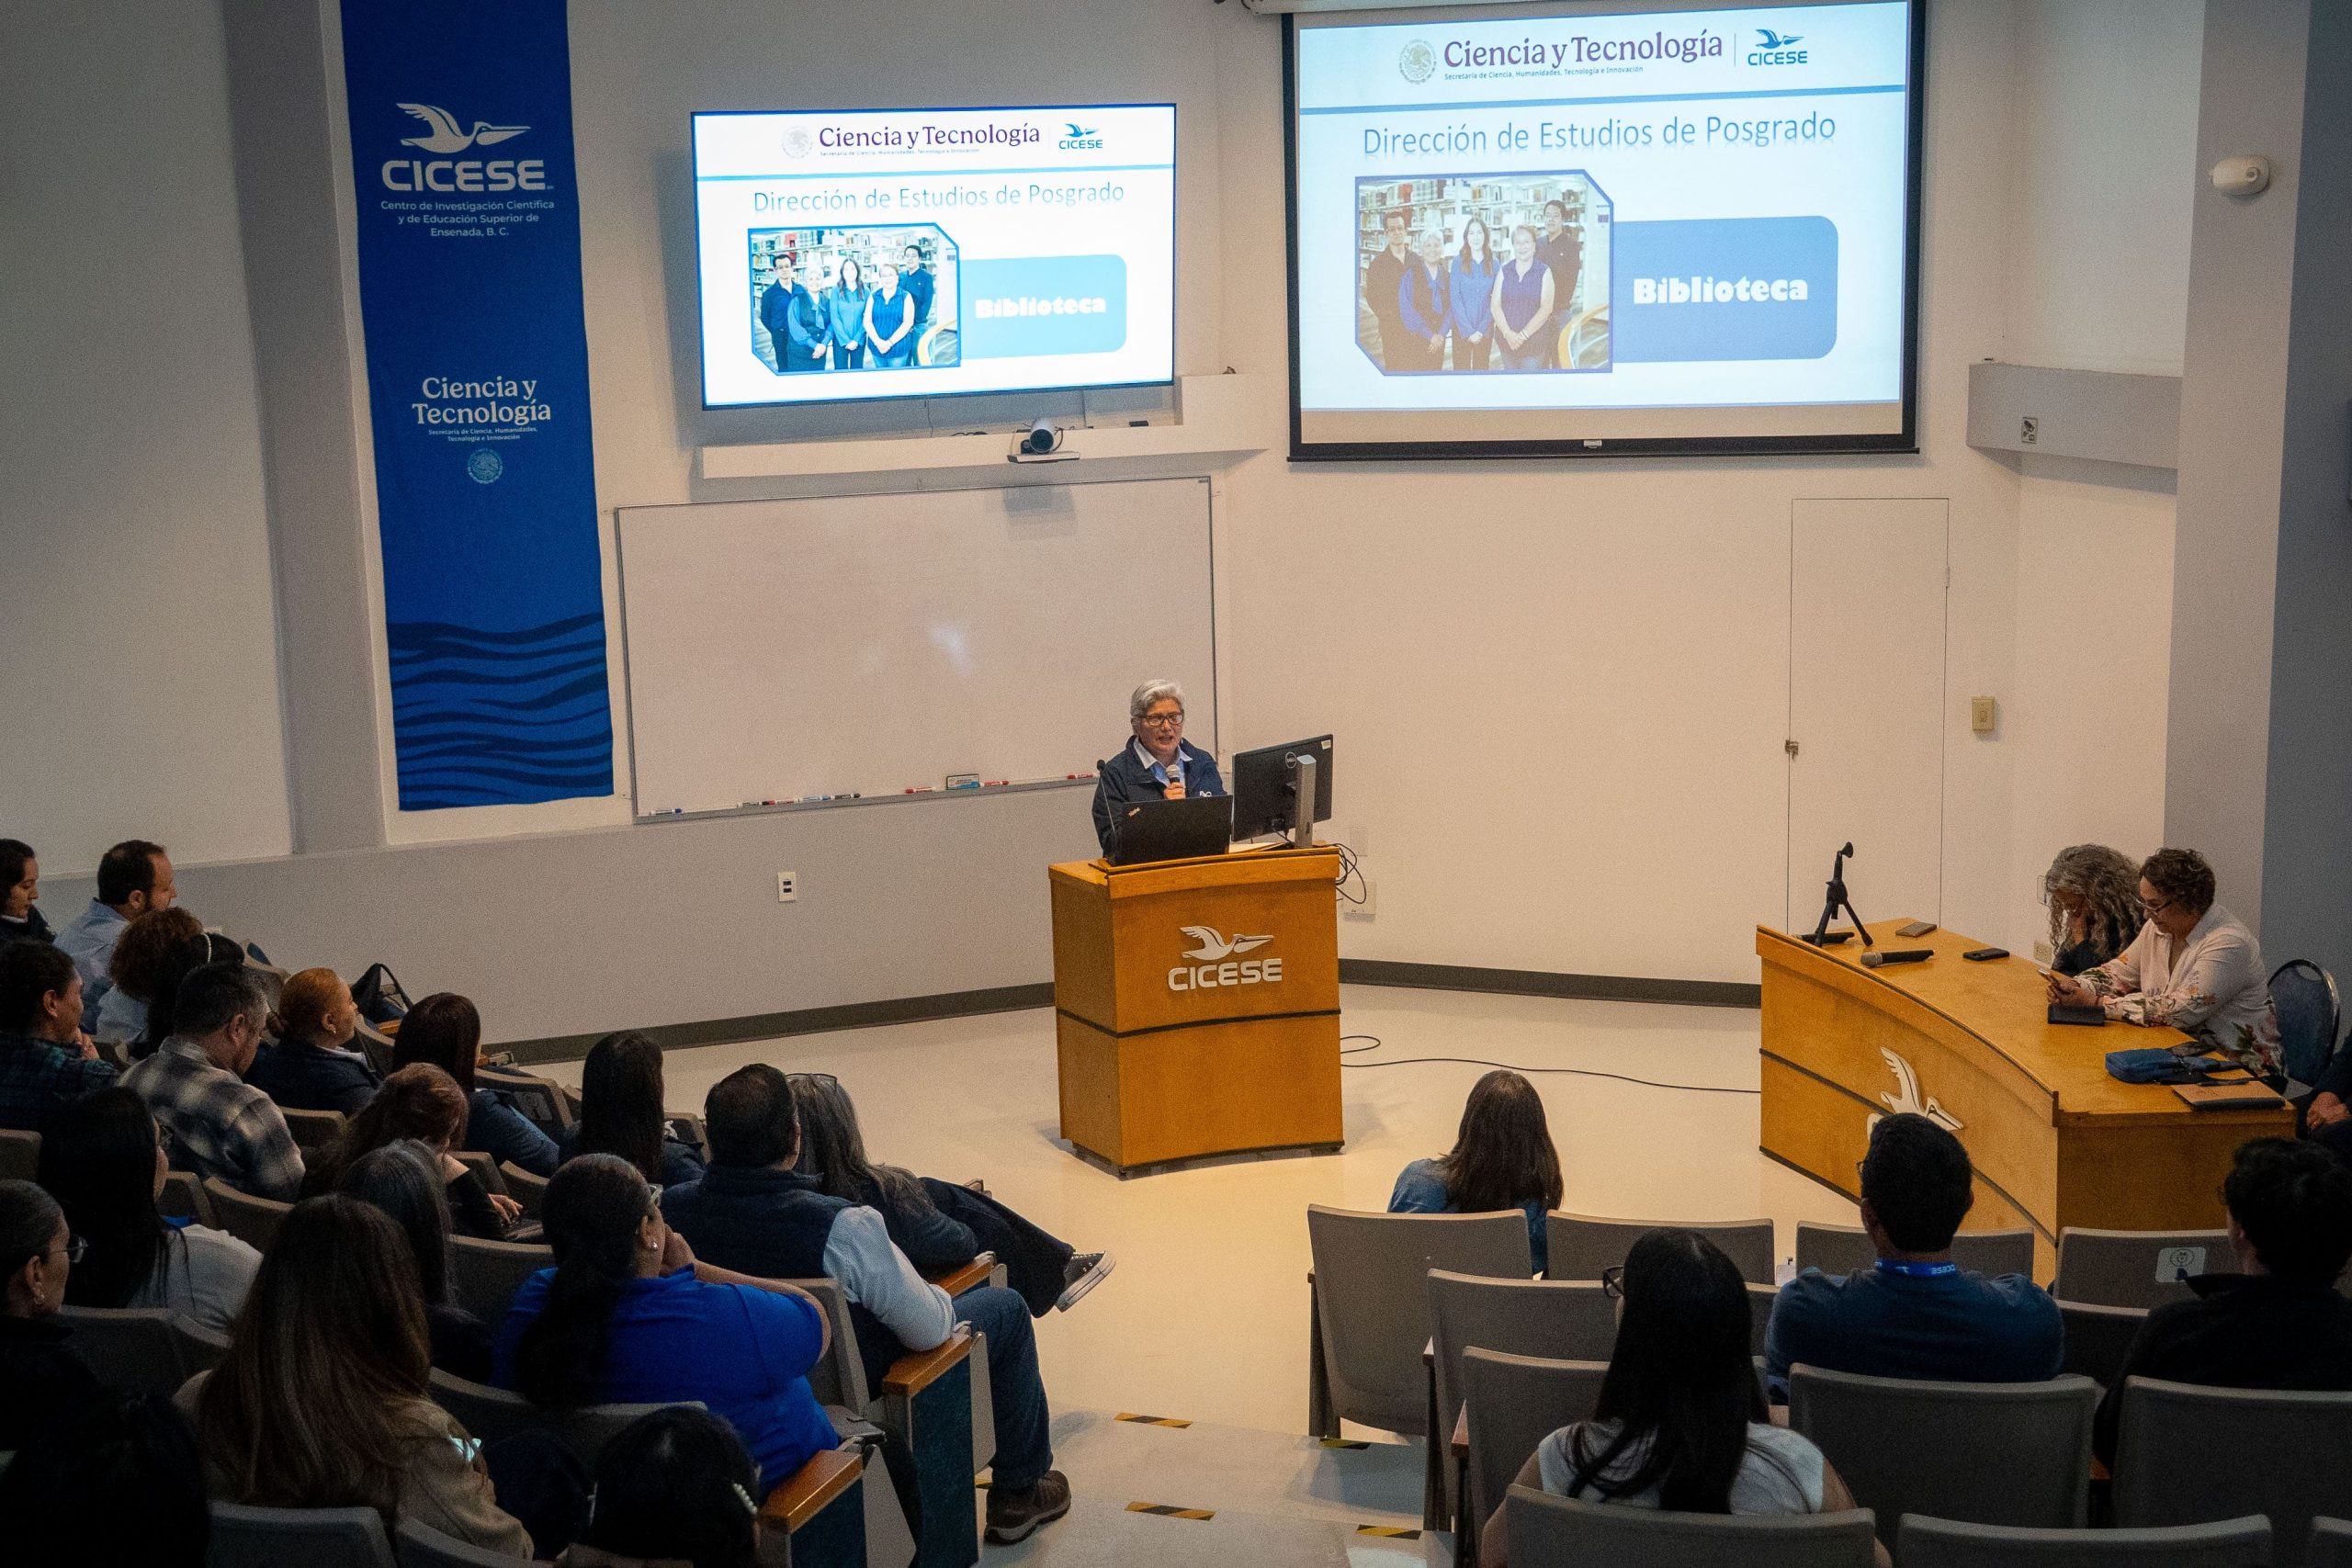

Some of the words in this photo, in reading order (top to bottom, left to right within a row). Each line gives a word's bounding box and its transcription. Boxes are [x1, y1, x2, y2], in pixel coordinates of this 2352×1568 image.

[1444, 39, 1545, 68] Ciencia
[1552, 44, 1568, 69] y
[1571, 28, 1723, 64] Tecnología
[1747, 51, 1808, 66] CICESE
[819, 127, 901, 147] Ciencia
[907, 132, 919, 149] y
[922, 122, 1040, 146] Tecnología
[1058, 139, 1103, 150] CICESE
[1364, 125, 1487, 154] Dirección
[1498, 122, 1529, 150] de
[1540, 119, 1653, 148] Estudios
[1663, 117, 1696, 143] de
[1707, 111, 1836, 146] Posgrado
[381, 160, 546, 191] CICESE
[380, 200, 416, 209] Centro
[419, 201, 433, 210] de
[435, 201, 503, 212] Investigación
[753, 189, 856, 212] Dirección
[865, 188, 890, 209] de
[899, 186, 988, 208] Estudios
[996, 185, 1021, 205] de
[1029, 182, 1124, 207] Posgrado
[398, 216, 404, 224] y
[407, 215, 420, 223] de
[424, 214, 477, 223] Educación
[480, 213, 523, 224] Superior
[526, 213, 539, 221] de
[431, 228, 484, 237] Ensenada,
[1634, 276, 1808, 305] Biblioteca
[975, 297, 1106, 319] Biblioteca
[422, 376, 518, 399] Ciencia
[522, 380, 537, 400] y
[412, 399, 551, 425] Tecnología
[1168, 958, 1283, 990] CICESE
